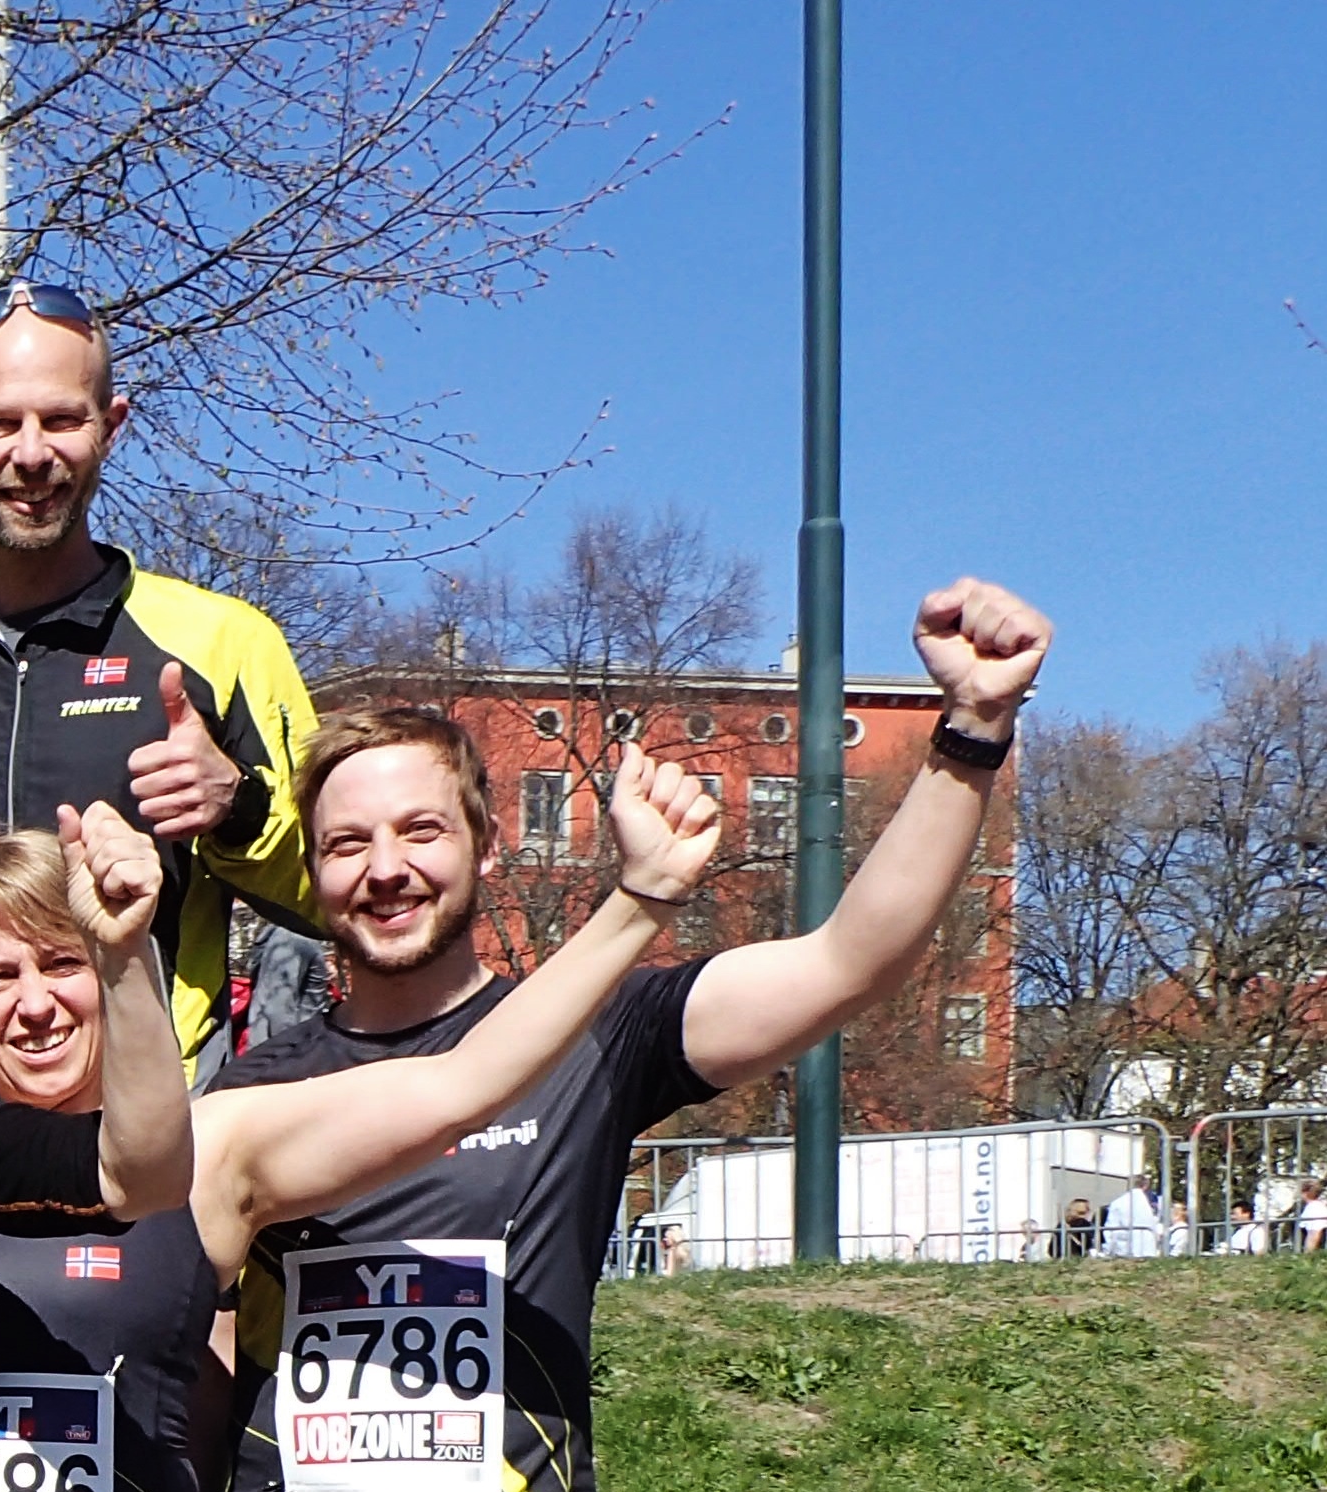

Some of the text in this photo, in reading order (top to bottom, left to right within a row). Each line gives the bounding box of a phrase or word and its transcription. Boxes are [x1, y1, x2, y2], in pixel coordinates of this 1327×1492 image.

[60, 697, 141, 717] TRIMTEX
[460, 1119, 538, 1150] injinji
[355, 1263, 420, 1304] YT
[291, 1316, 490, 1403] 6786
[433, 1443, 483, 1462] ZONE
